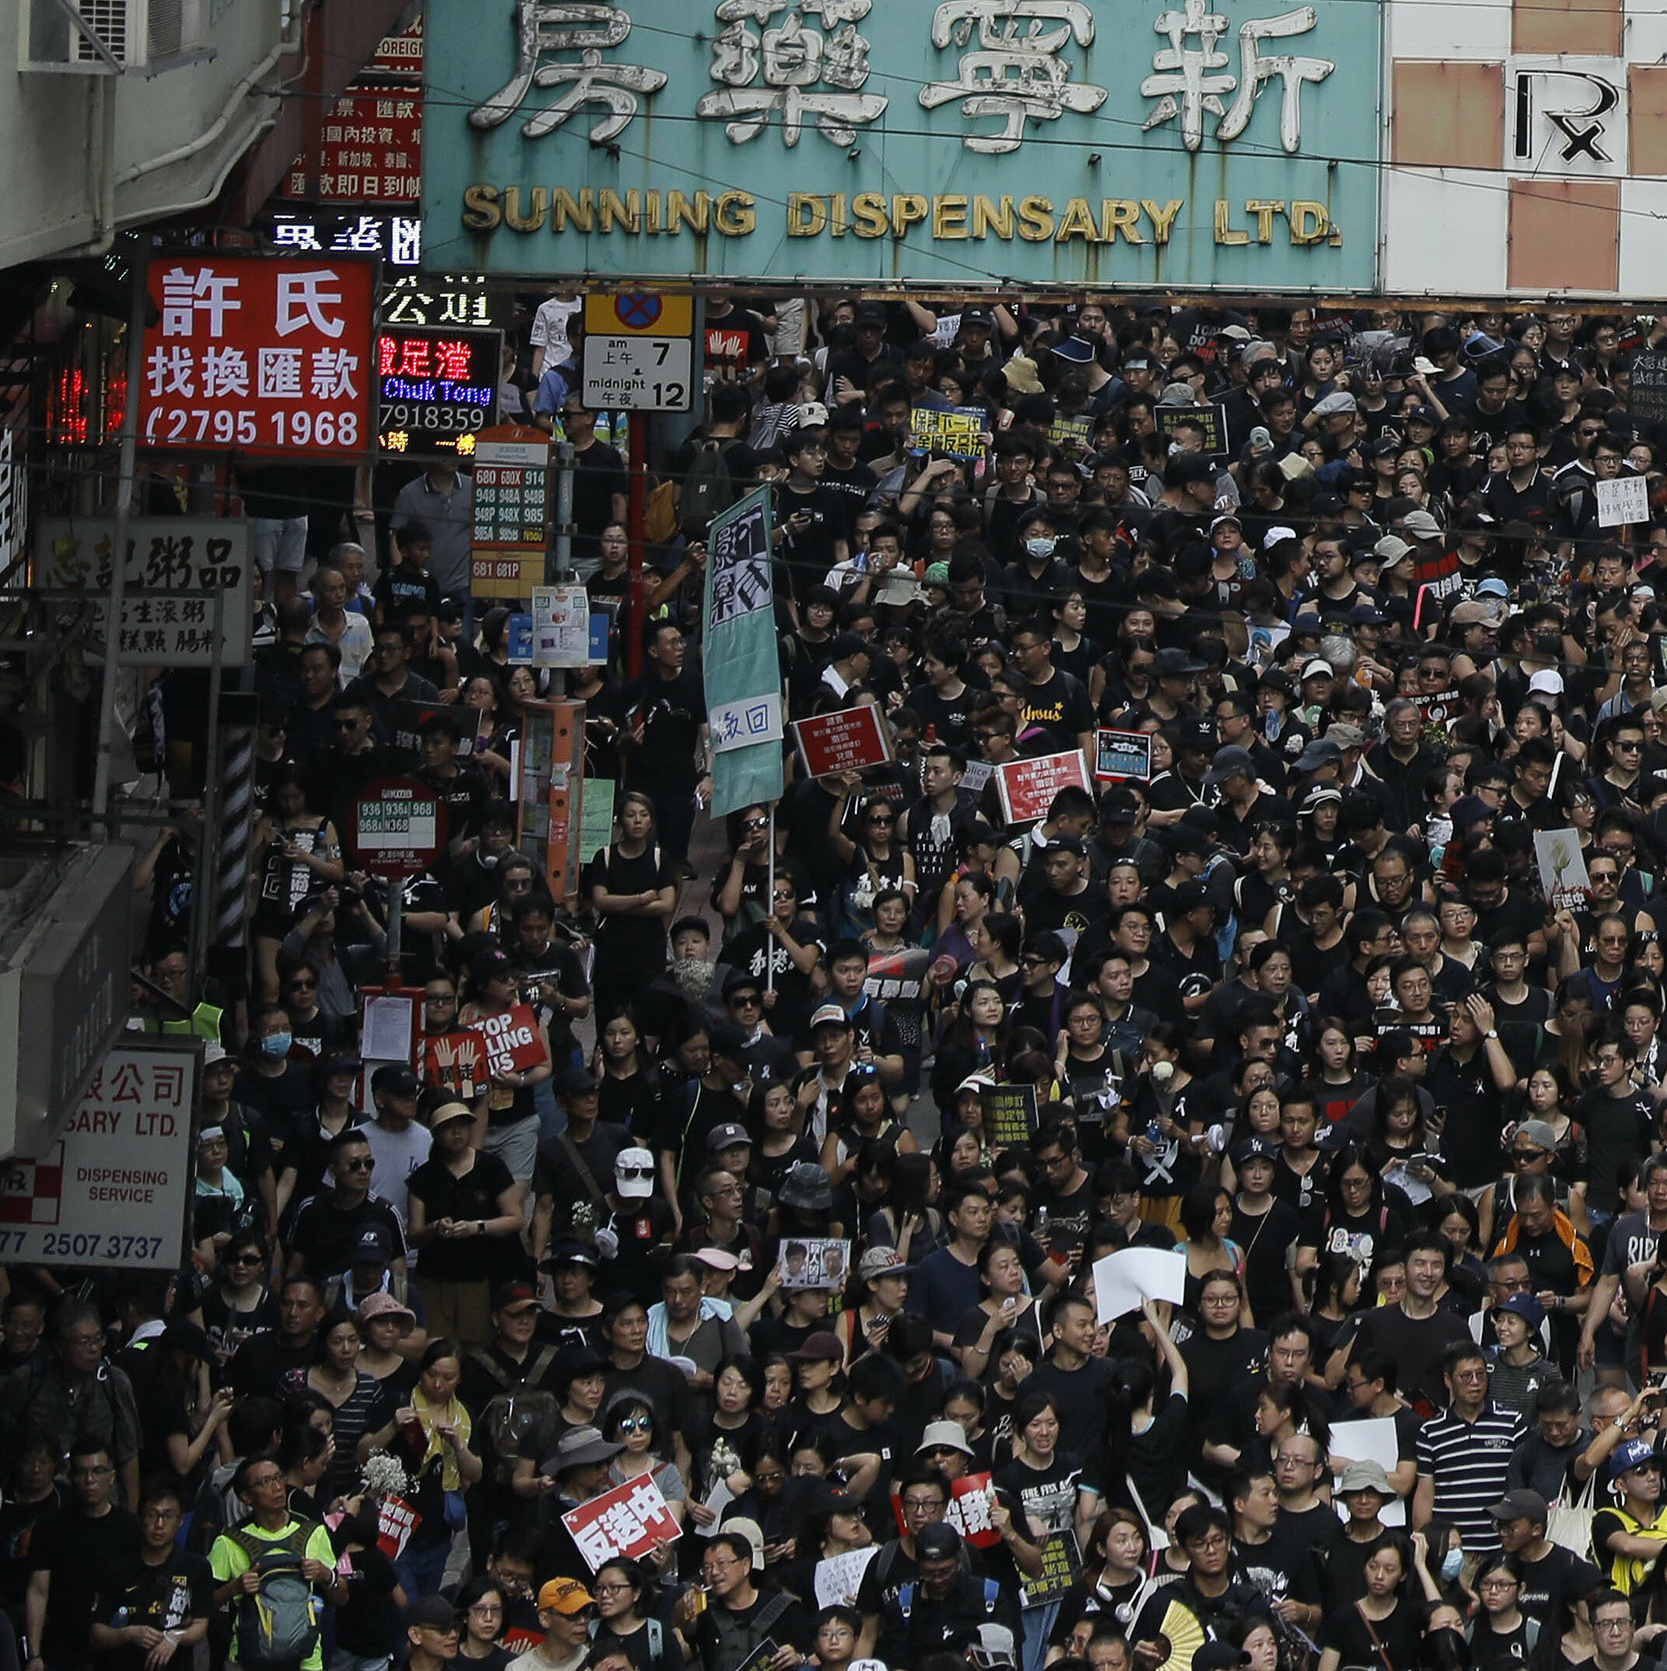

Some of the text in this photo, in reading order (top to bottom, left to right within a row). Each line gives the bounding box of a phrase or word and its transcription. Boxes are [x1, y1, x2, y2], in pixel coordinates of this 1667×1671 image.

[463, 183, 1343, 248] SUNNING DISPENSARY LTD.
[160, 266, 348, 336] 許氏
[602, 352, 633, 366] 上午
[608, 340, 670, 365] am 7
[146, 348, 362, 400] 找換匯款
[589, 377, 683, 406] midnight 12
[166, 408, 358, 446] 2795 1968
[475, 470, 496, 485] 680
[524, 470, 544, 486] 914
[475, 489, 495, 504] 948
[524, 508, 544, 523] 985
[473, 562, 493, 577] 681
[361, 803, 432, 816] 936 968
[487, 1054, 516, 1077] US
[134, 1112, 178, 1138] LTD.
[76, 1167, 168, 1188] DISPENSING
[88, 1186, 153, 1204] SERVICE
[43, 1232, 163, 1260] 2507 3737
[591, 1483, 667, 1566] 反送中
